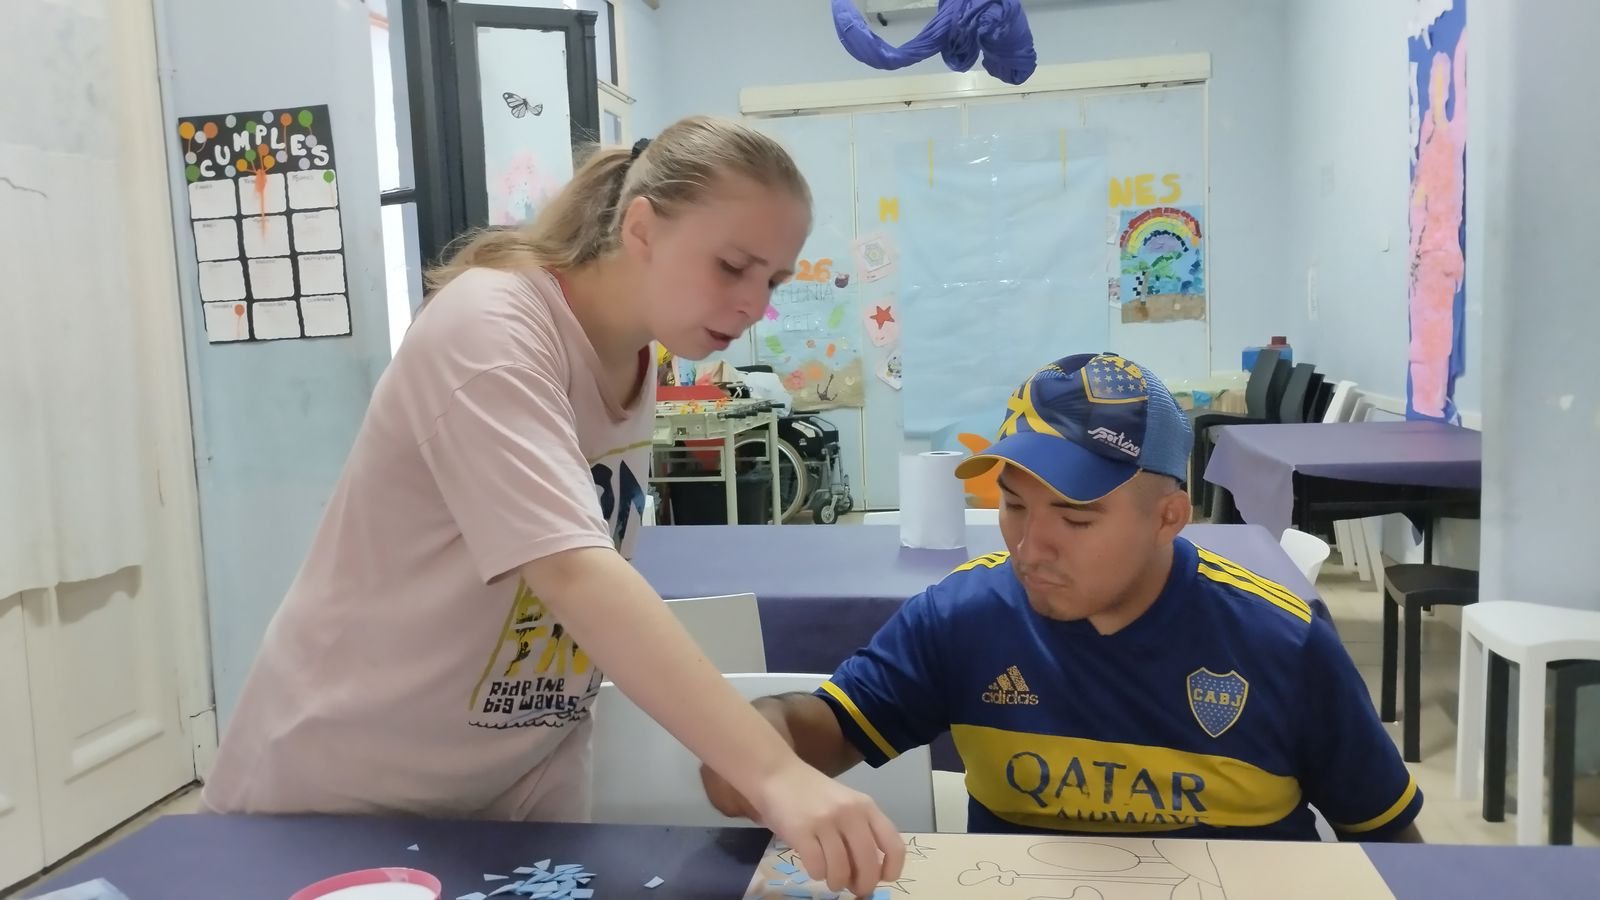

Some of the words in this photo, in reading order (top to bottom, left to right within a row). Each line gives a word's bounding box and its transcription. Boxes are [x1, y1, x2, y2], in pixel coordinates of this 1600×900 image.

[200, 124, 330, 178] CUMPLES
[1108, 172, 1182, 208] NES
[489, 680, 532, 697] Ride
[981, 690, 1039, 706] adidas
[1192, 687, 1243, 707] CABJ
[483, 697, 515, 714] big
[518, 694, 580, 713] waves
[1005, 751, 1207, 812] QATAR
